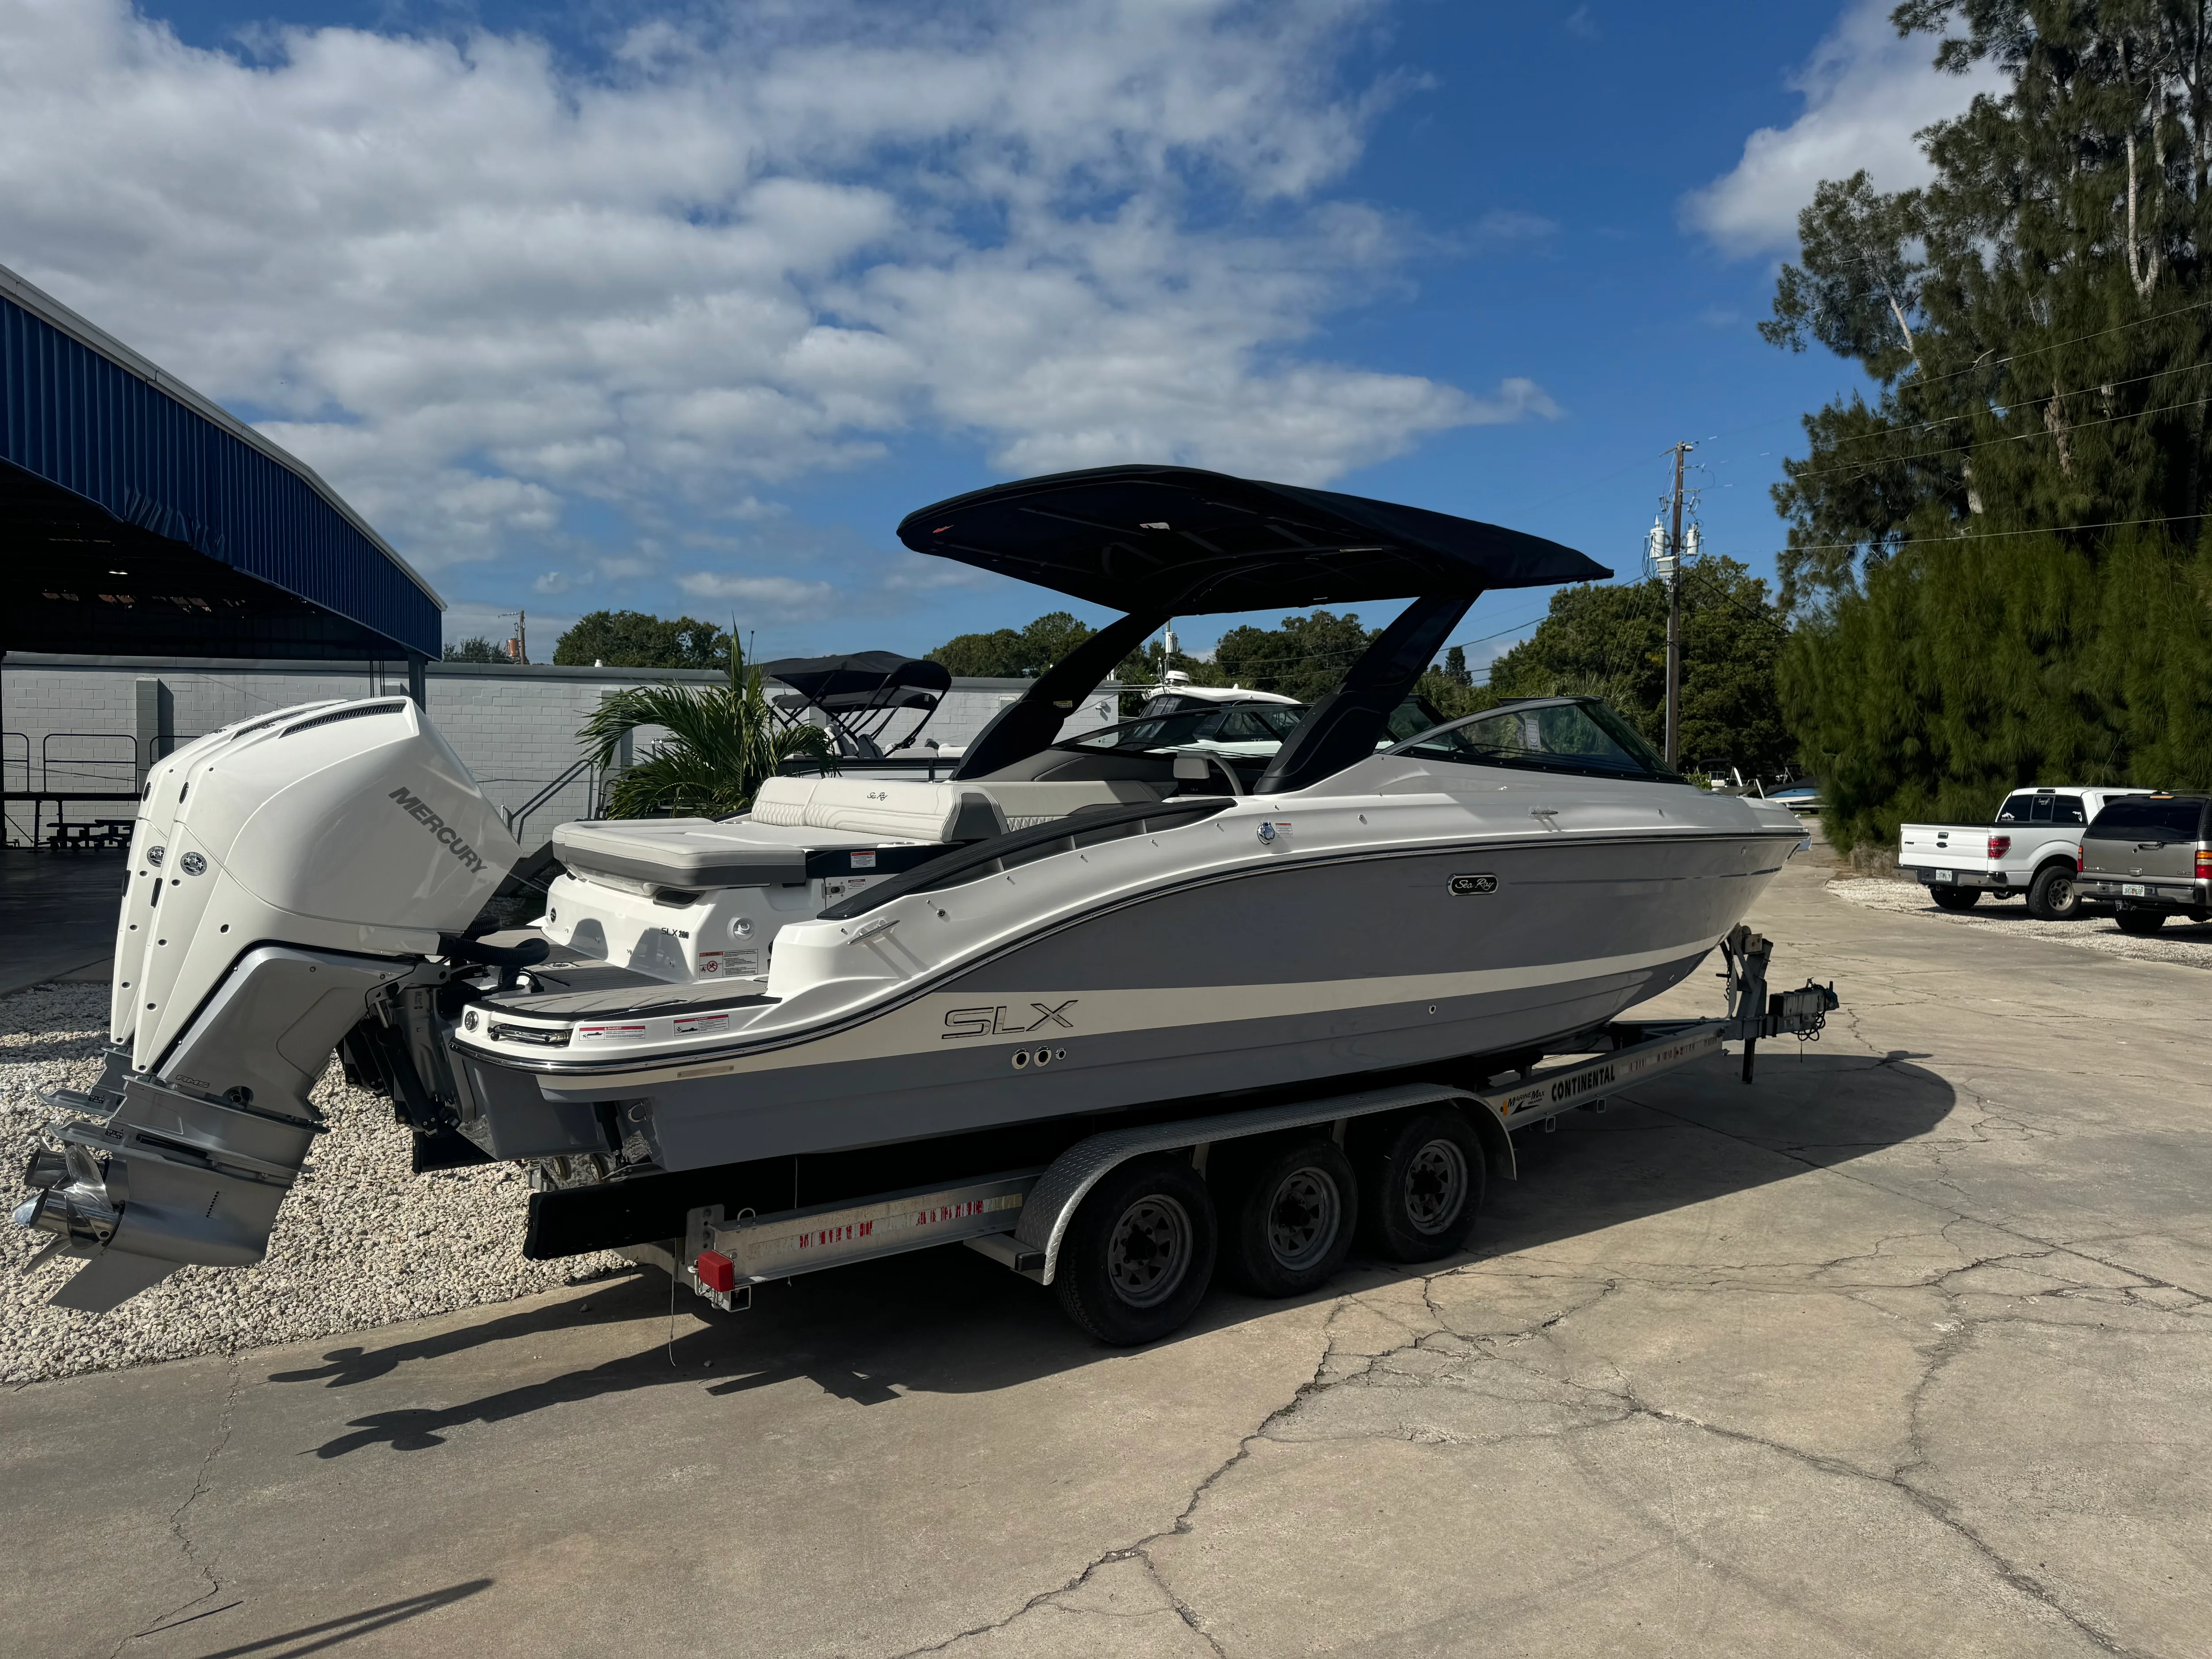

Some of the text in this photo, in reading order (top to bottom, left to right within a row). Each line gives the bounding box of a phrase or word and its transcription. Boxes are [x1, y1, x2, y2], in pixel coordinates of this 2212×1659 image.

[388, 787, 489, 874] MERCURY
[1455, 878, 1494, 891] Sea Ray
[661, 927, 678, 937] SLX
[941, 1000, 1079, 1039] SLX
[175, 1075, 210, 1088] AMS
[1551, 1064, 1615, 1102] CONTINENTAL
